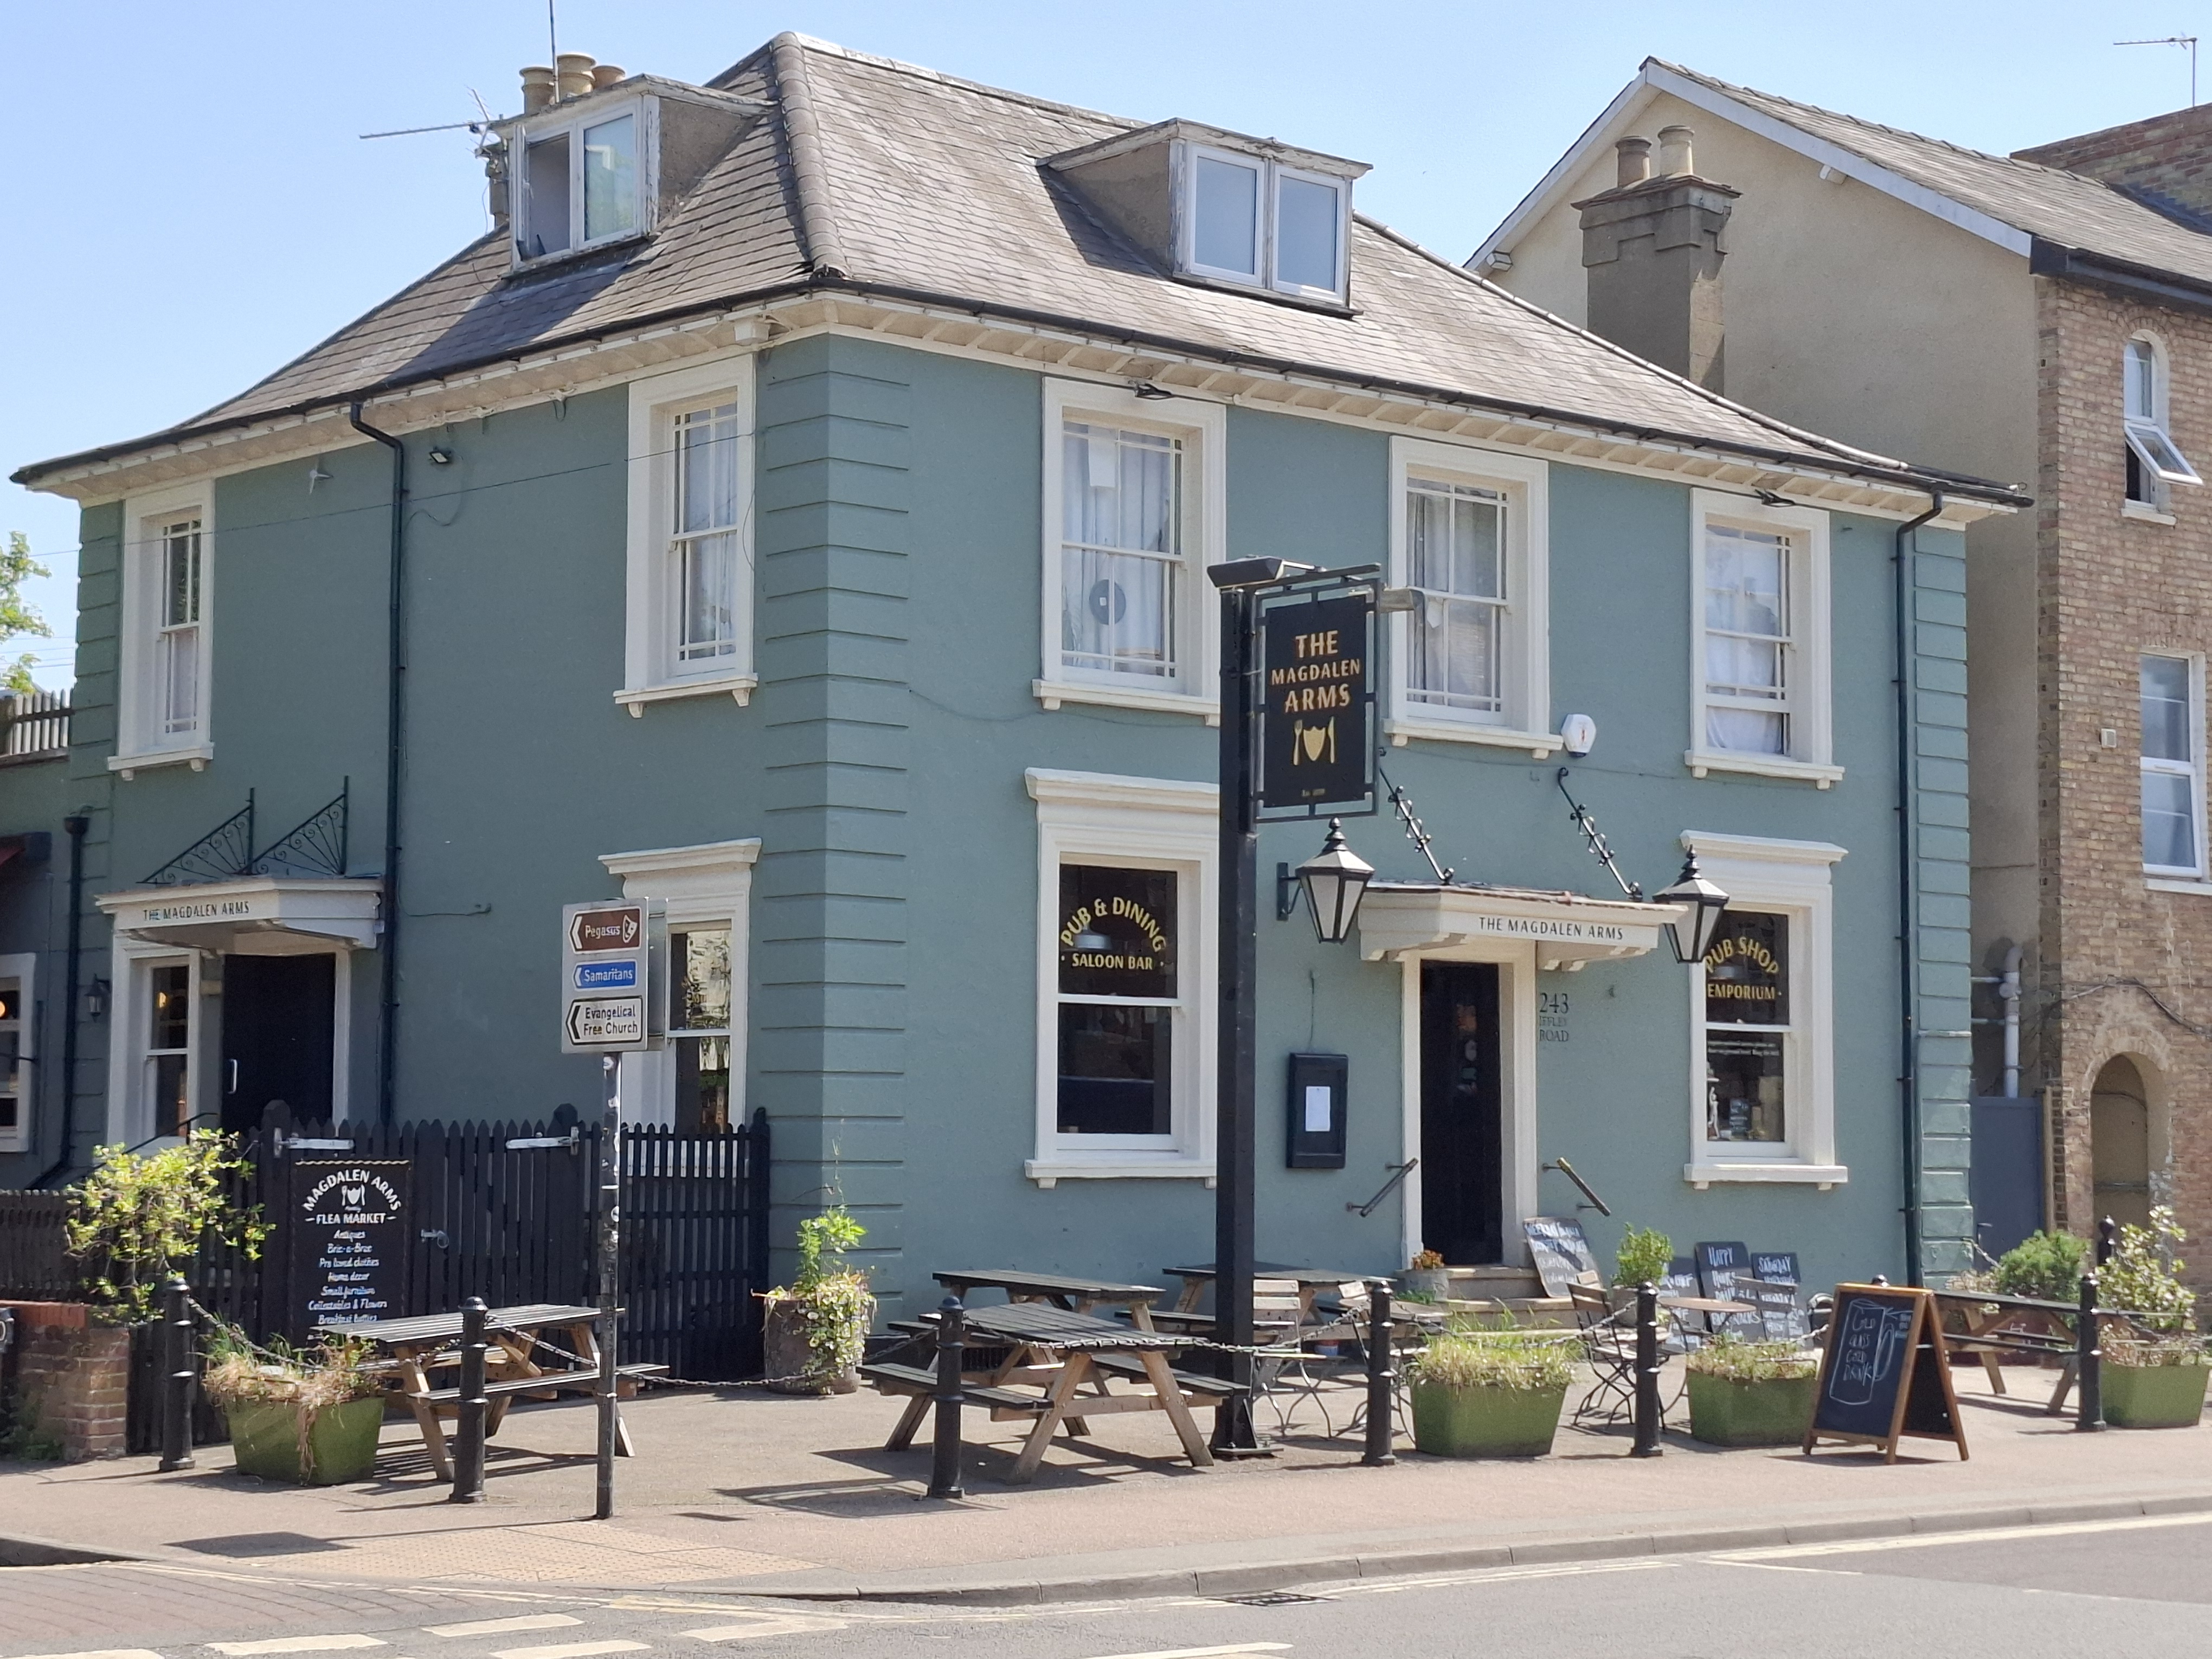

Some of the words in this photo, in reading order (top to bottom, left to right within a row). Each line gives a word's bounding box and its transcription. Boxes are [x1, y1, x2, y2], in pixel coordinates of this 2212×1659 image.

[1295, 631, 1339, 658] THE
[1271, 659, 1360, 686] MAGDALEN
[1284, 683, 1352, 713] ARMS
[143, 909, 161, 921] THE
[163, 904, 217, 920] MAGDALEN
[221, 901, 249, 915] ARMS
[584, 924, 621, 940] Pegasus
[1060, 906, 1091, 947] PUB
[1094, 898, 1108, 917] &
[1112, 896, 1167, 953] DINING
[1479, 917, 1502, 931] THE
[1507, 918, 1582, 937] MAGDALEN
[1587, 925, 1623, 940] ARMS
[1071, 953, 1124, 969] SALOON
[1128, 956, 1153, 970] BAR
[1704, 938, 1734, 974] PUB
[1738, 936, 1779, 974] SHOP
[584, 968, 633, 982] Samaritans
[1707, 983, 1776, 1000] EMPORIUM
[585, 1004, 636, 1020] Evangelical
[1539, 992, 1569, 1014] 243
[583, 1023, 602, 1036] Free
[605, 1021, 638, 1033] Church
[303, 1168, 370, 1211] MAGDALEN
[371, 1175, 402, 1211] ARMS
[316, 1214, 341, 1224] FLEA
[343, 1212, 387, 1224] MARKET
[333, 1229, 366, 1243] Antiques
[1708, 1245, 1733, 1268] HAPPY
